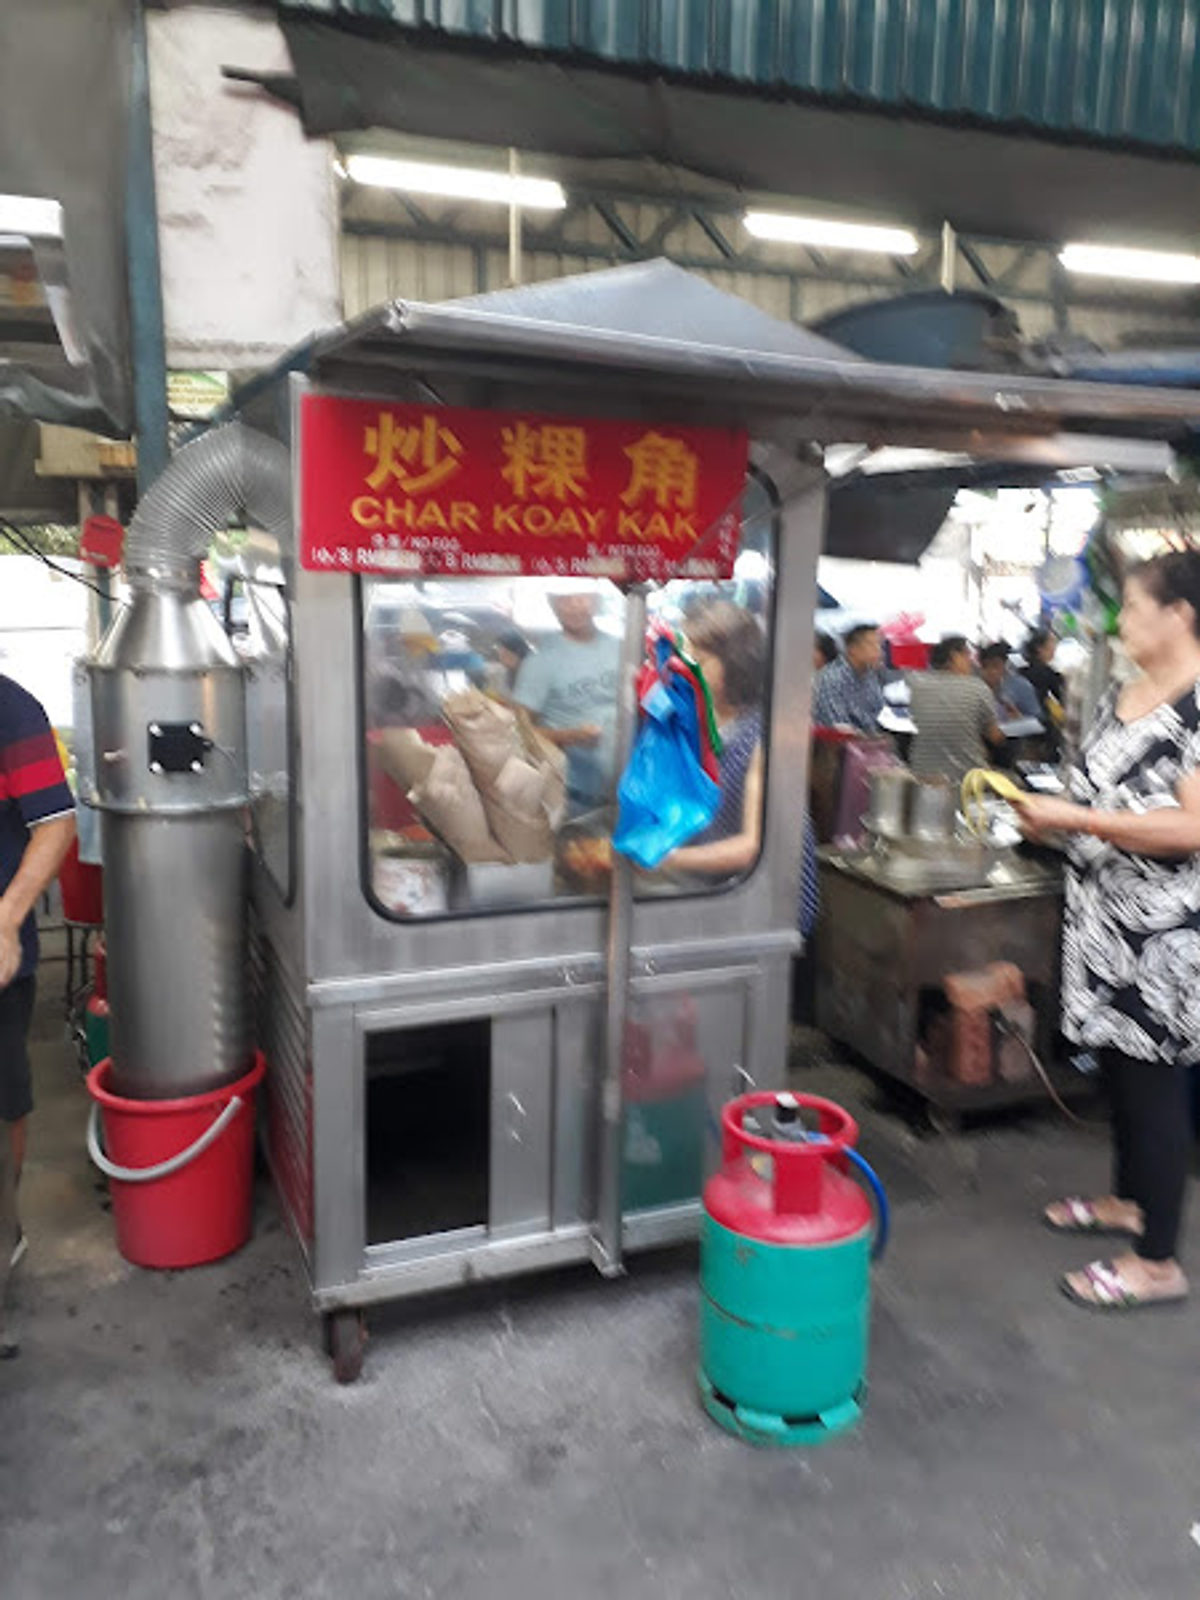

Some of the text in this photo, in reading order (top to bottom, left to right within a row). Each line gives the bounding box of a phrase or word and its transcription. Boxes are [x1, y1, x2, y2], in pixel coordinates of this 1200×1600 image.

[363, 410, 699, 511] 炒粿角
[351, 495, 482, 534] CHAR
[492, 503, 607, 538] KOAY
[617, 509, 700, 543] KAK
